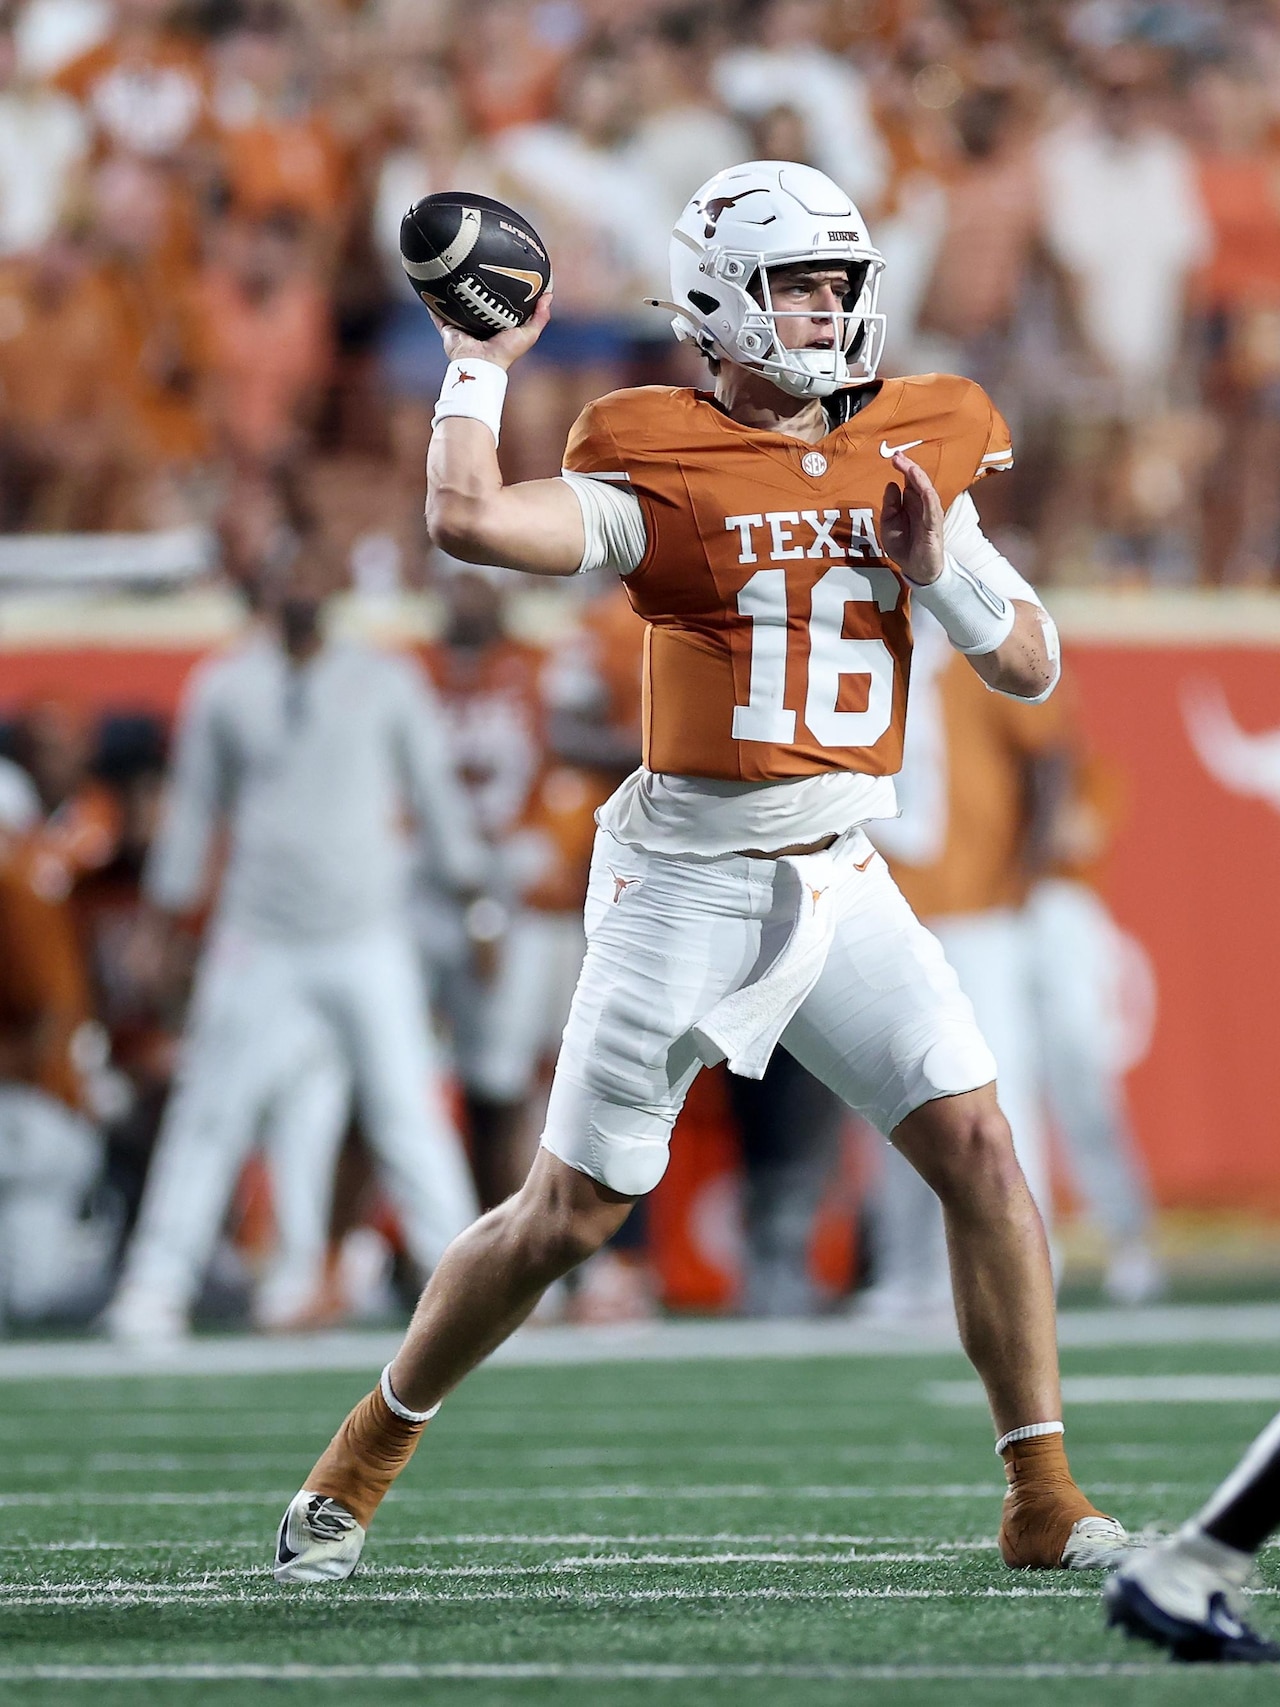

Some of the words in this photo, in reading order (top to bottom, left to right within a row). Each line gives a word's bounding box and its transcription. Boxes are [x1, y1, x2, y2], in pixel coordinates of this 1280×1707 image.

[803, 453, 827, 475] SEC
[725, 508, 888, 564] TEXA
[731, 566, 901, 747] 16
